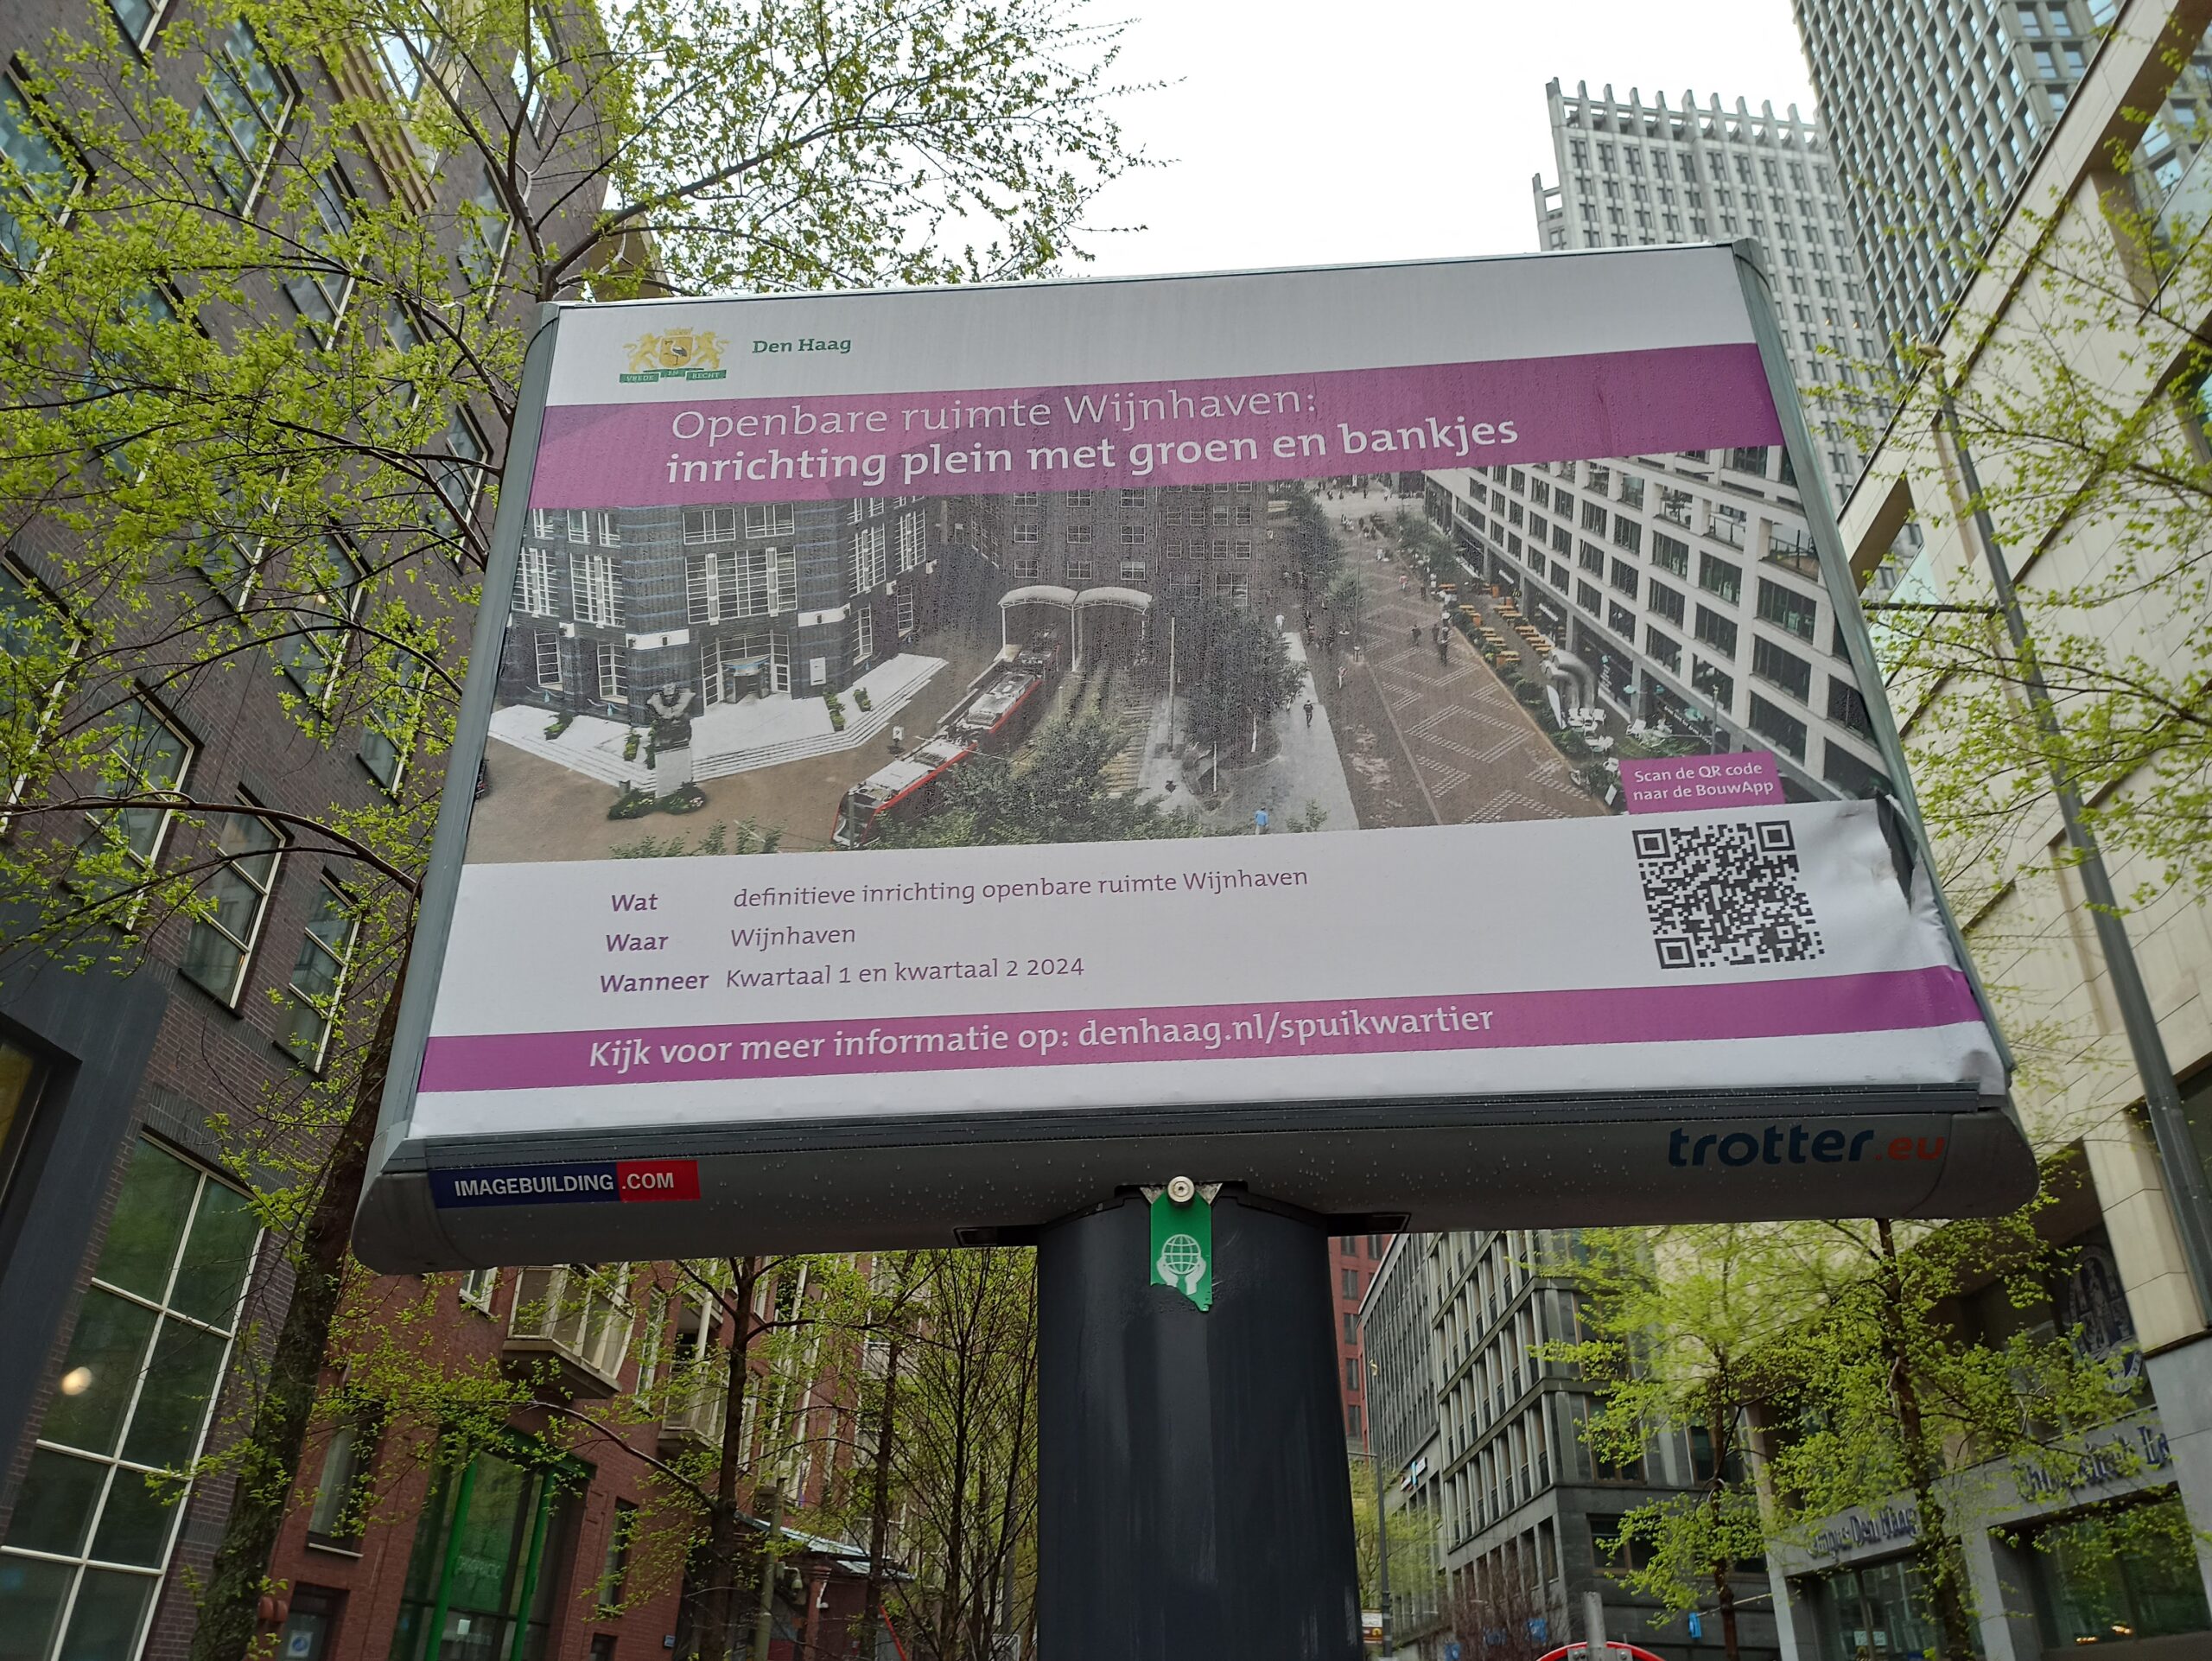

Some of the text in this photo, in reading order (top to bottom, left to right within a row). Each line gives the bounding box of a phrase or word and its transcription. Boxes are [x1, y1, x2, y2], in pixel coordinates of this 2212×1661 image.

[752, 338, 851, 354] Den Haag
[672, 389, 1314, 447] Openbare ruimte Wijnhaven:
[666, 416, 1518, 486] inrichting plein met groen en bankjes
[1634, 762, 1762, 782] Scan de QR code
[1633, 781, 1773, 800] naar de BouwApp
[612, 869, 1307, 912] Wat definitieve inrichting openbare ruimte Wijnhaven
[606, 926, 855, 951] Waar Wijnhaven
[601, 958, 1084, 993] Wanneer Kwartaal 1 en kwartaal 2 2024
[590, 1006, 1493, 1074] Kijk voor meer informatie op: denhaag.nl/spuikwartier
[1668, 1124, 1944, 1167] trotter.eu
[1850, 1515, 1880, 1545] Den
